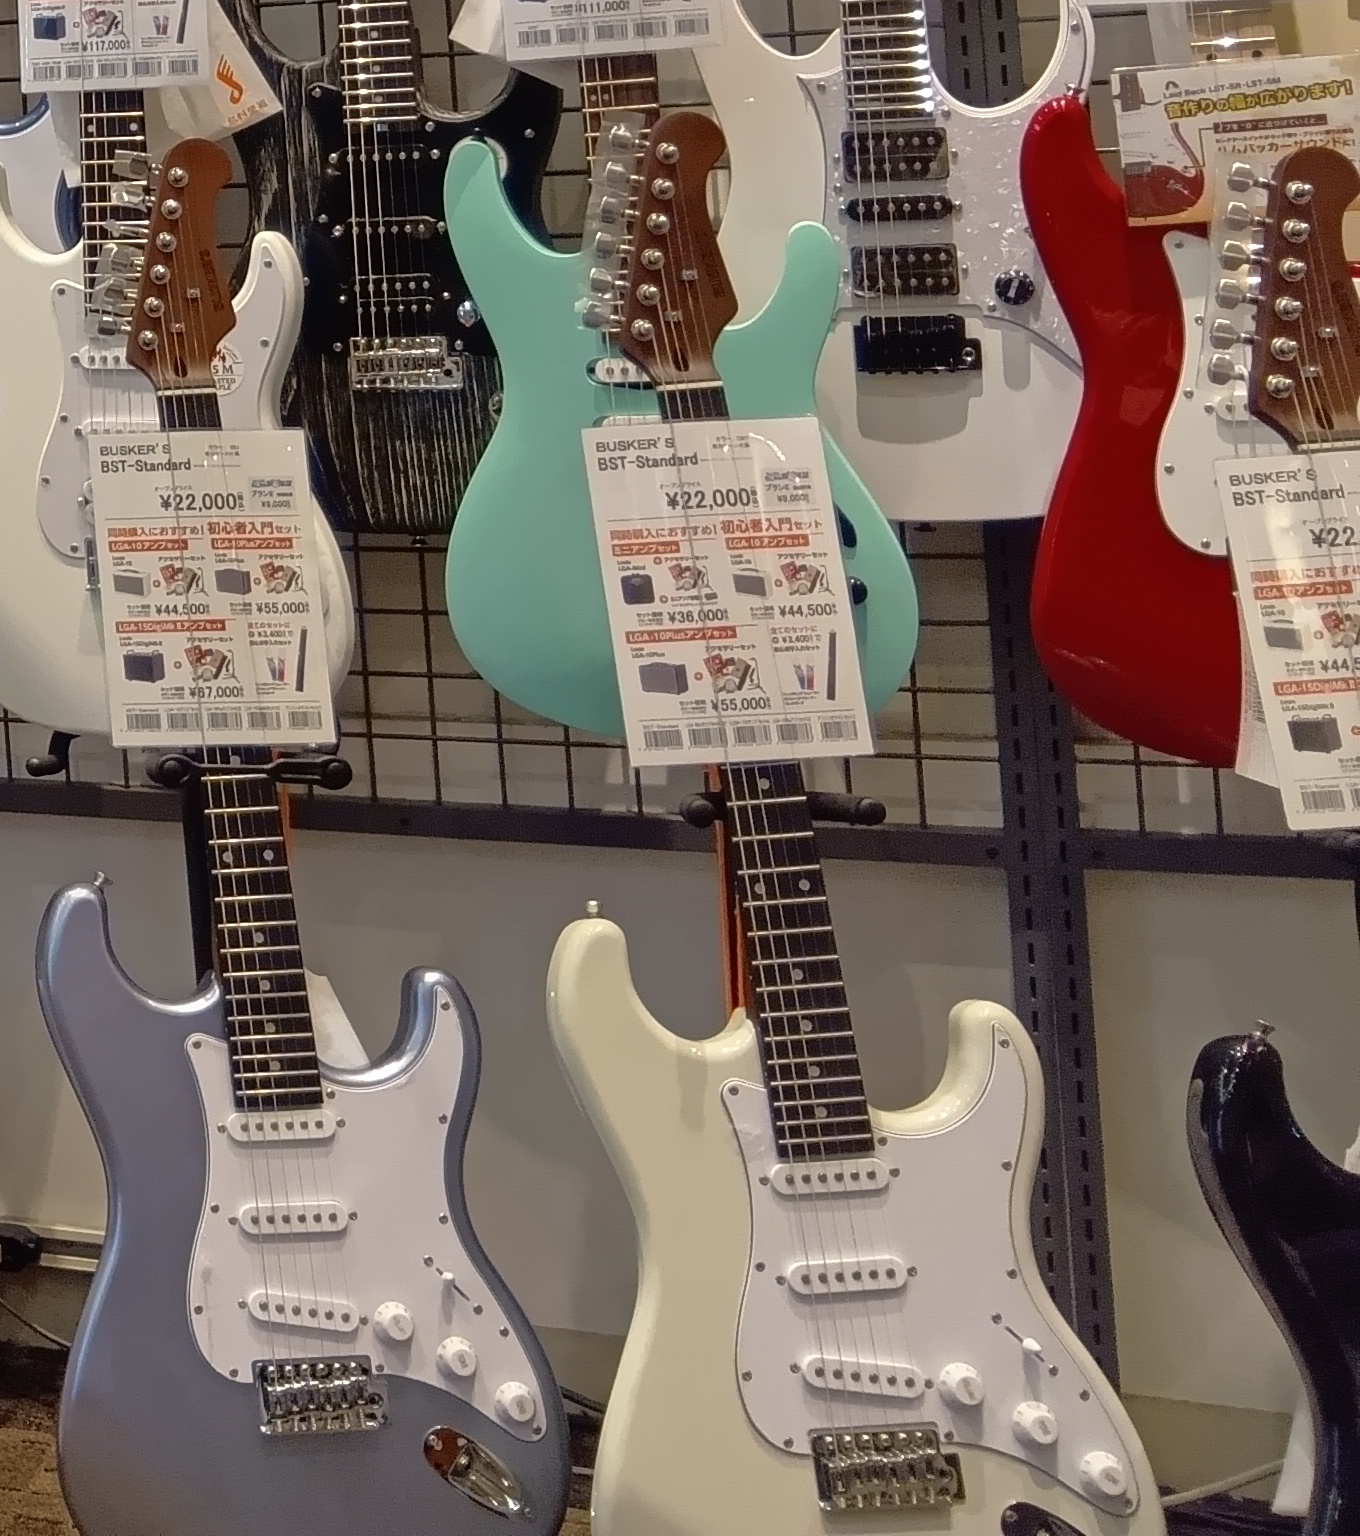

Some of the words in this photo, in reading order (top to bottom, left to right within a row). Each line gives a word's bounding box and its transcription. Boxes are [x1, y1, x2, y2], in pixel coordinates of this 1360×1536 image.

[101, 458, 191, 473] BST-Standard
[598, 454, 699, 471] BST-Standard
[160, 492, 237, 511] ¥22,000
[666, 488, 750, 510] ¥22,000
[1232, 486, 1344, 506] BST-Standard
[207, 521, 301, 535] 初心者入門セット
[720, 518, 823, 534] 初心者入門セット
[614, 544, 678, 555] ミニアンプセット
[155, 603, 206, 616] ¥44,500
[256, 602, 305, 613] ¥55,000
[667, 609, 725, 624] ¥36,000
[778, 604, 833, 618] ¥44,500
[711, 697, 767, 712] ¥55,000
